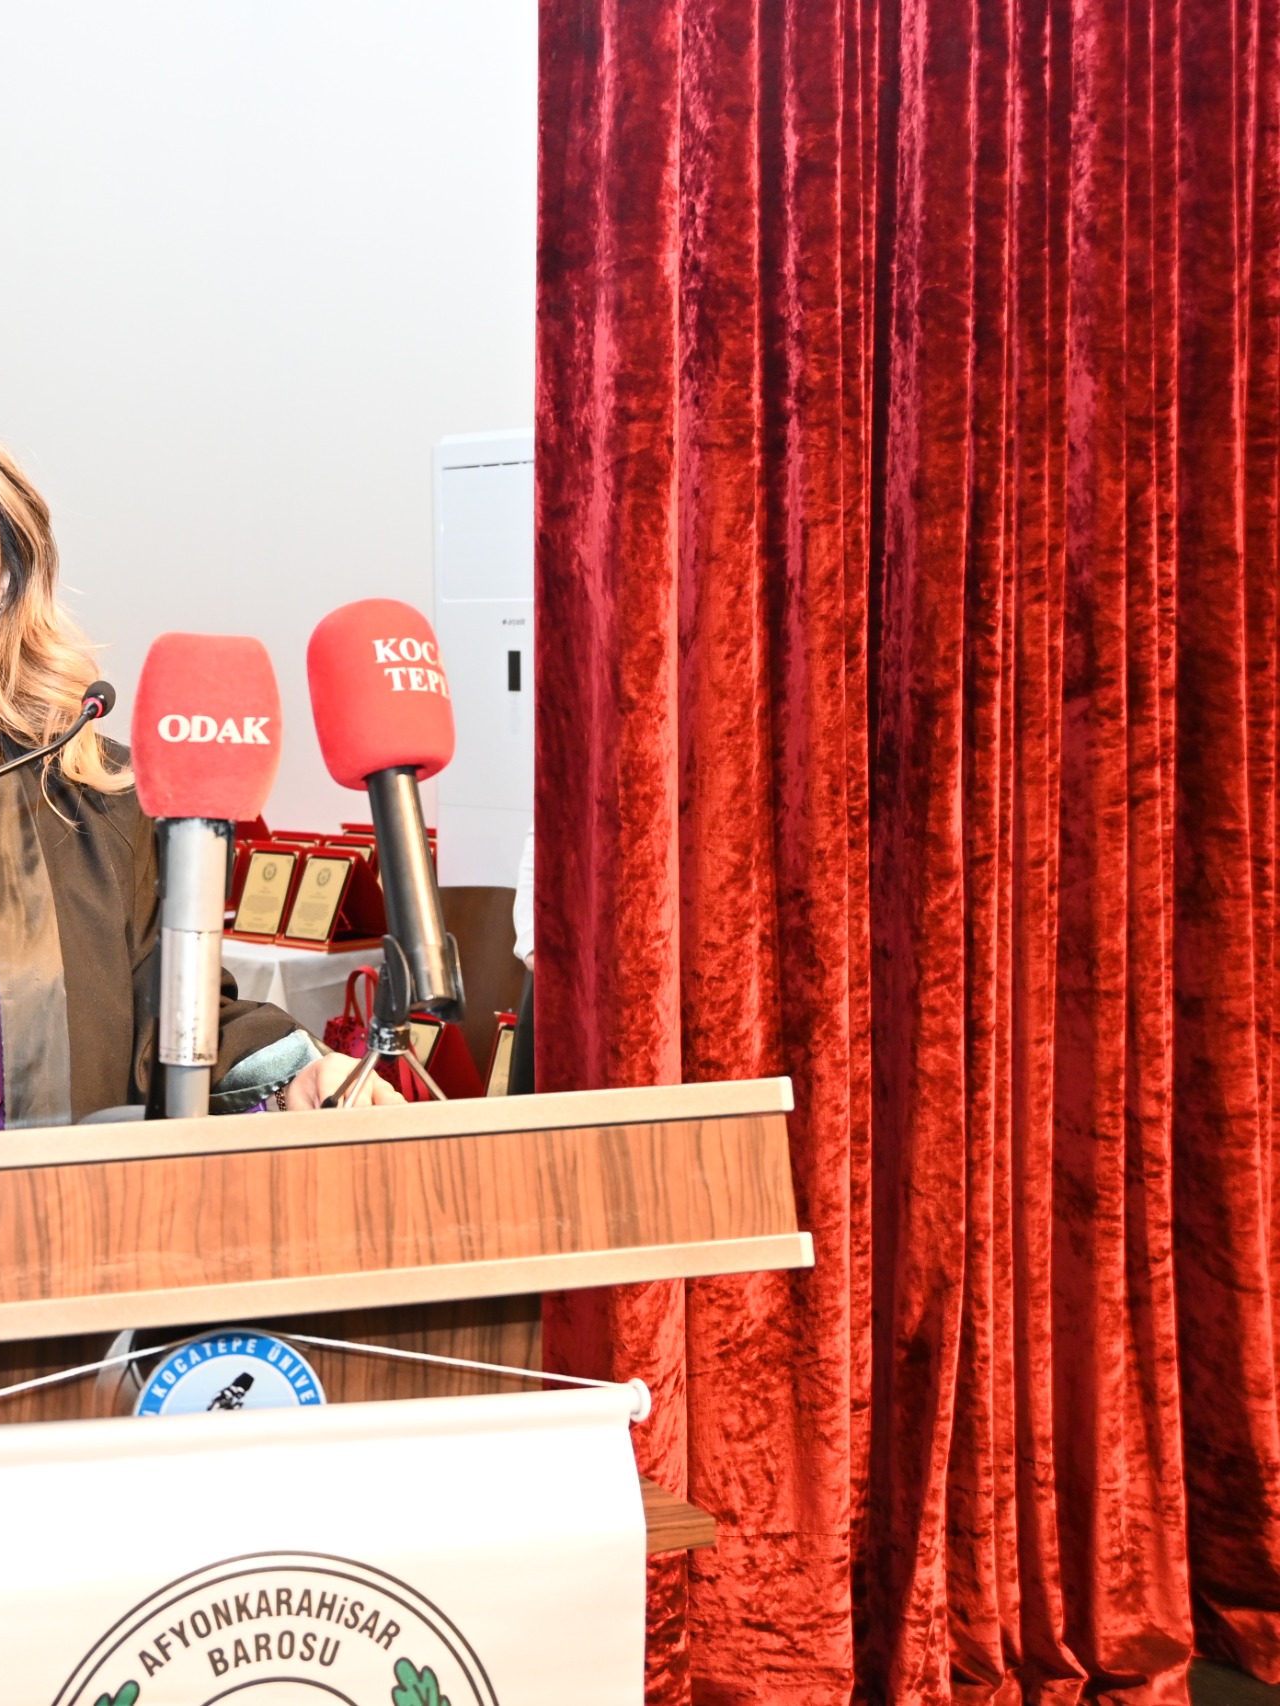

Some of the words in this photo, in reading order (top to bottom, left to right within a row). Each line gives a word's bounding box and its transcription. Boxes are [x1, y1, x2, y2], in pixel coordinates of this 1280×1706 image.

[372, 637, 444, 668] KOC
[158, 714, 271, 745] ODAK
[151, 1337, 259, 1400] KOCATEPE
[207, 1630, 340, 1677] BAROSU
